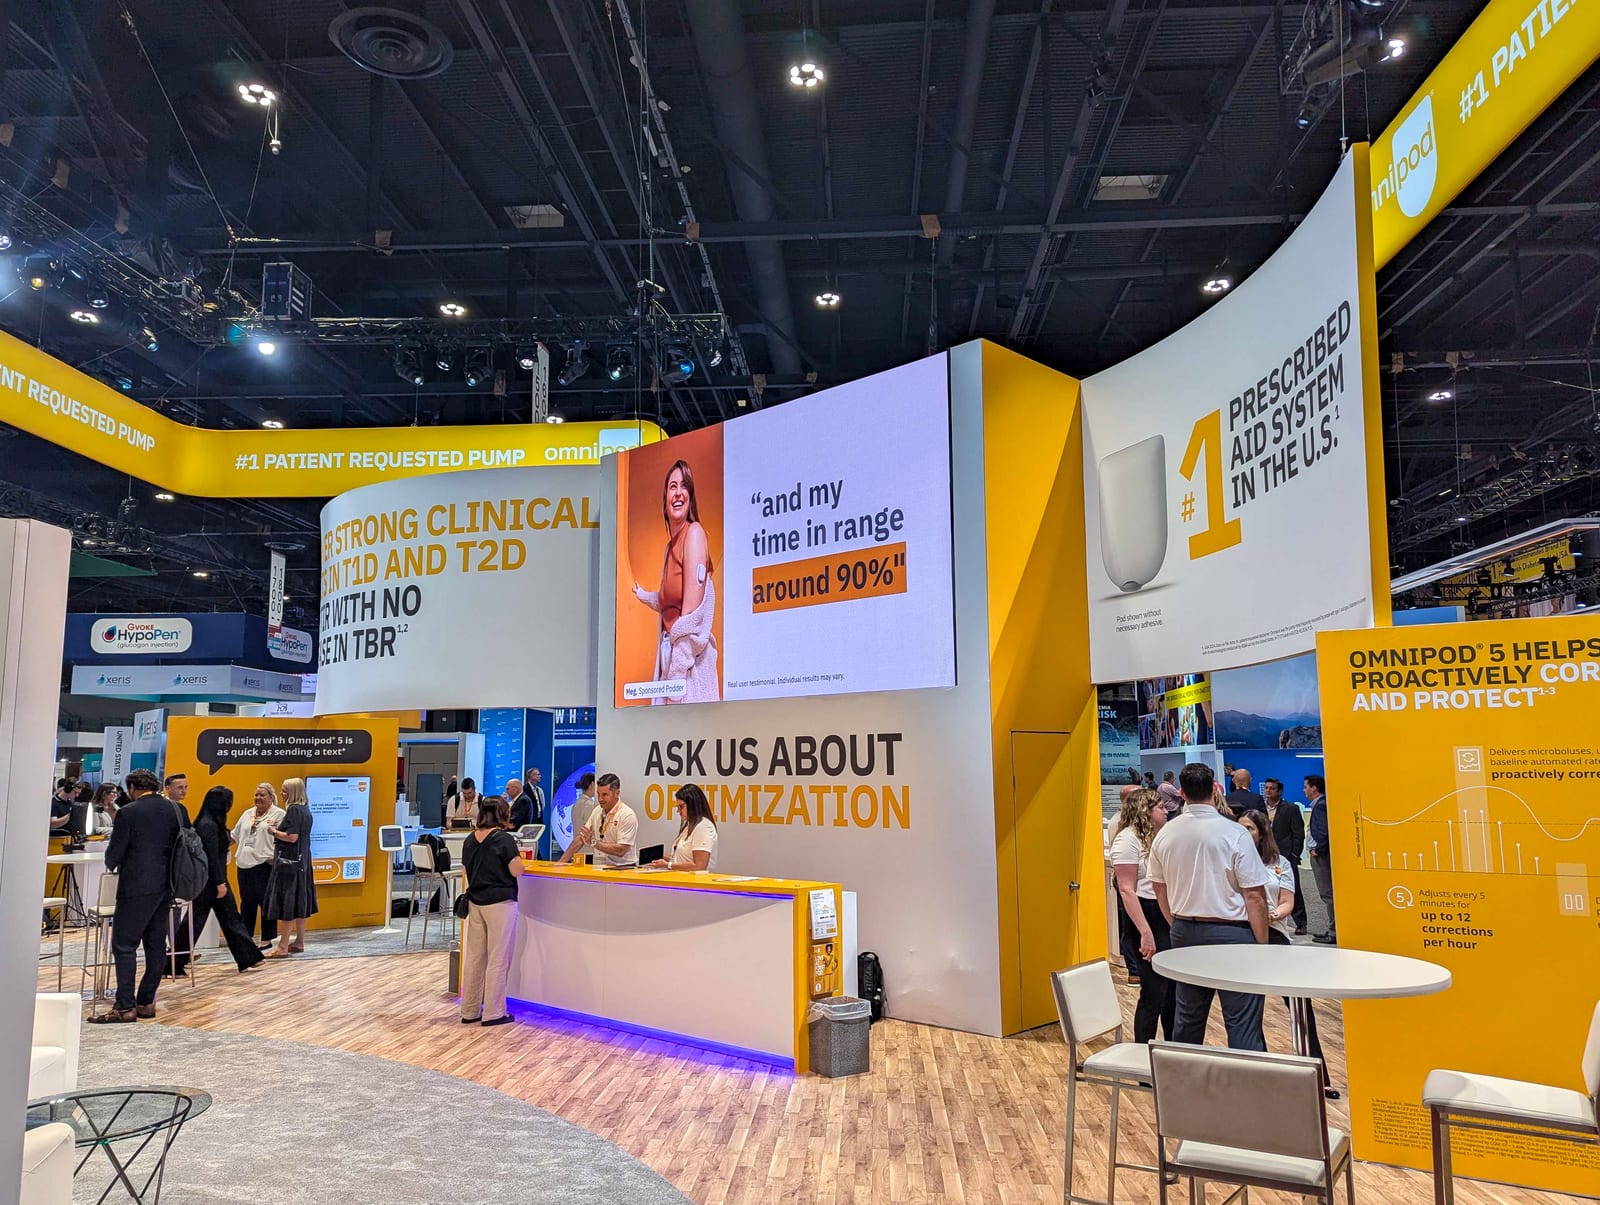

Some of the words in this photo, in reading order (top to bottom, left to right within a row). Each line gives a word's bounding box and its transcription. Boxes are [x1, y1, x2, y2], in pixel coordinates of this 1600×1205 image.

[1458, 70, 1490, 124] #1
[1491, 0, 1577, 88] PATIE
[1371, 121, 1433, 211] nipod
[1229, 299, 1352, 433] PRESCRIBED
[0, 363, 26, 393] NT
[28, 378, 116, 436] REQUESTED
[118, 422, 156, 452] PUMP
[1230, 420, 1267, 472] AID
[1272, 353, 1345, 445] SYSTEM
[234, 453, 260, 471] #1
[264, 452, 345, 470] PATIENT
[349, 450, 464, 471] REQUESTED
[468, 449, 526, 466] PUMP
[1231, 466, 1256, 509] IN
[1259, 439, 1299, 494] THE
[809, 479, 843, 510] my
[322, 530, 334, 562] ER
[335, 508, 418, 555] STRONG
[426, 496, 600, 537] CLINICAL
[752, 528, 800, 557] time
[807, 519, 827, 548] in
[834, 506, 905, 542] range
[328, 562, 340, 594] IN
[343, 552, 379, 588] T1D
[384, 543, 447, 581] AND
[456, 538, 527, 573] T2D
[752, 565, 830, 605] around
[332, 590, 376, 628] WITH
[382, 584, 422, 619] NO
[1127, 612, 1142, 622] shown
[1142, 608, 1162, 619] without
[1115, 623, 1140, 633] necessary
[319, 635, 332, 667] SE
[333, 631, 348, 664] IN
[1490, 643, 1506, 662] 5
[1512, 637, 1600, 662] HELPS
[105, 675, 131, 685] xeris
[182, 675, 208, 684] xeris
[727, 681, 738, 689] Real
[777, 676, 802, 685] Individual
[802, 674, 820, 682] results
[820, 673, 832, 682] may
[1351, 664, 1533, 690] PROACTIVELY
[638, 685, 665, 696] Sponsored
[666, 683, 685, 693] Podder
[1352, 692, 1407, 712] AND
[115, 730, 123, 753] UNITED
[217, 748, 229, 756] as
[230, 747, 259, 758] quick
[260, 748, 272, 756] as
[274, 747, 312, 758] sending
[314, 748, 321, 756] a
[218, 736, 261, 747] Bolusing
[263, 736, 286, 745] with
[337, 736, 343, 745] 5
[345, 736, 353, 745] is
[1489, 748, 1526, 756] Delivers
[1528, 747, 1594, 756] microboluses,
[113, 753, 122, 776] STATES
[644, 739, 707, 777] ASK
[715, 737, 759, 776] US
[768, 732, 903, 777] ABOUT
[1490, 758, 1528, 766] baseline
[1530, 757, 1582, 766] automated
[1491, 769, 1565, 781] proactively
[644, 783, 911, 830] OPIMIZATION
[1396, 892, 1405, 903] 5
[1418, 889, 1451, 899] Adjusts
[1453, 891, 1478, 901] every
[1479, 891, 1486, 900] 5
[1419, 900, 1456, 909] minutes
[1457, 900, 1470, 909] for
[1421, 911, 1437, 922] up
[1440, 911, 1453, 921] to
[1456, 912, 1471, 922] 12
[1422, 924, 1494, 937] corrections
[1423, 938, 1444, 949] per
[1447, 938, 1478, 949] hour
